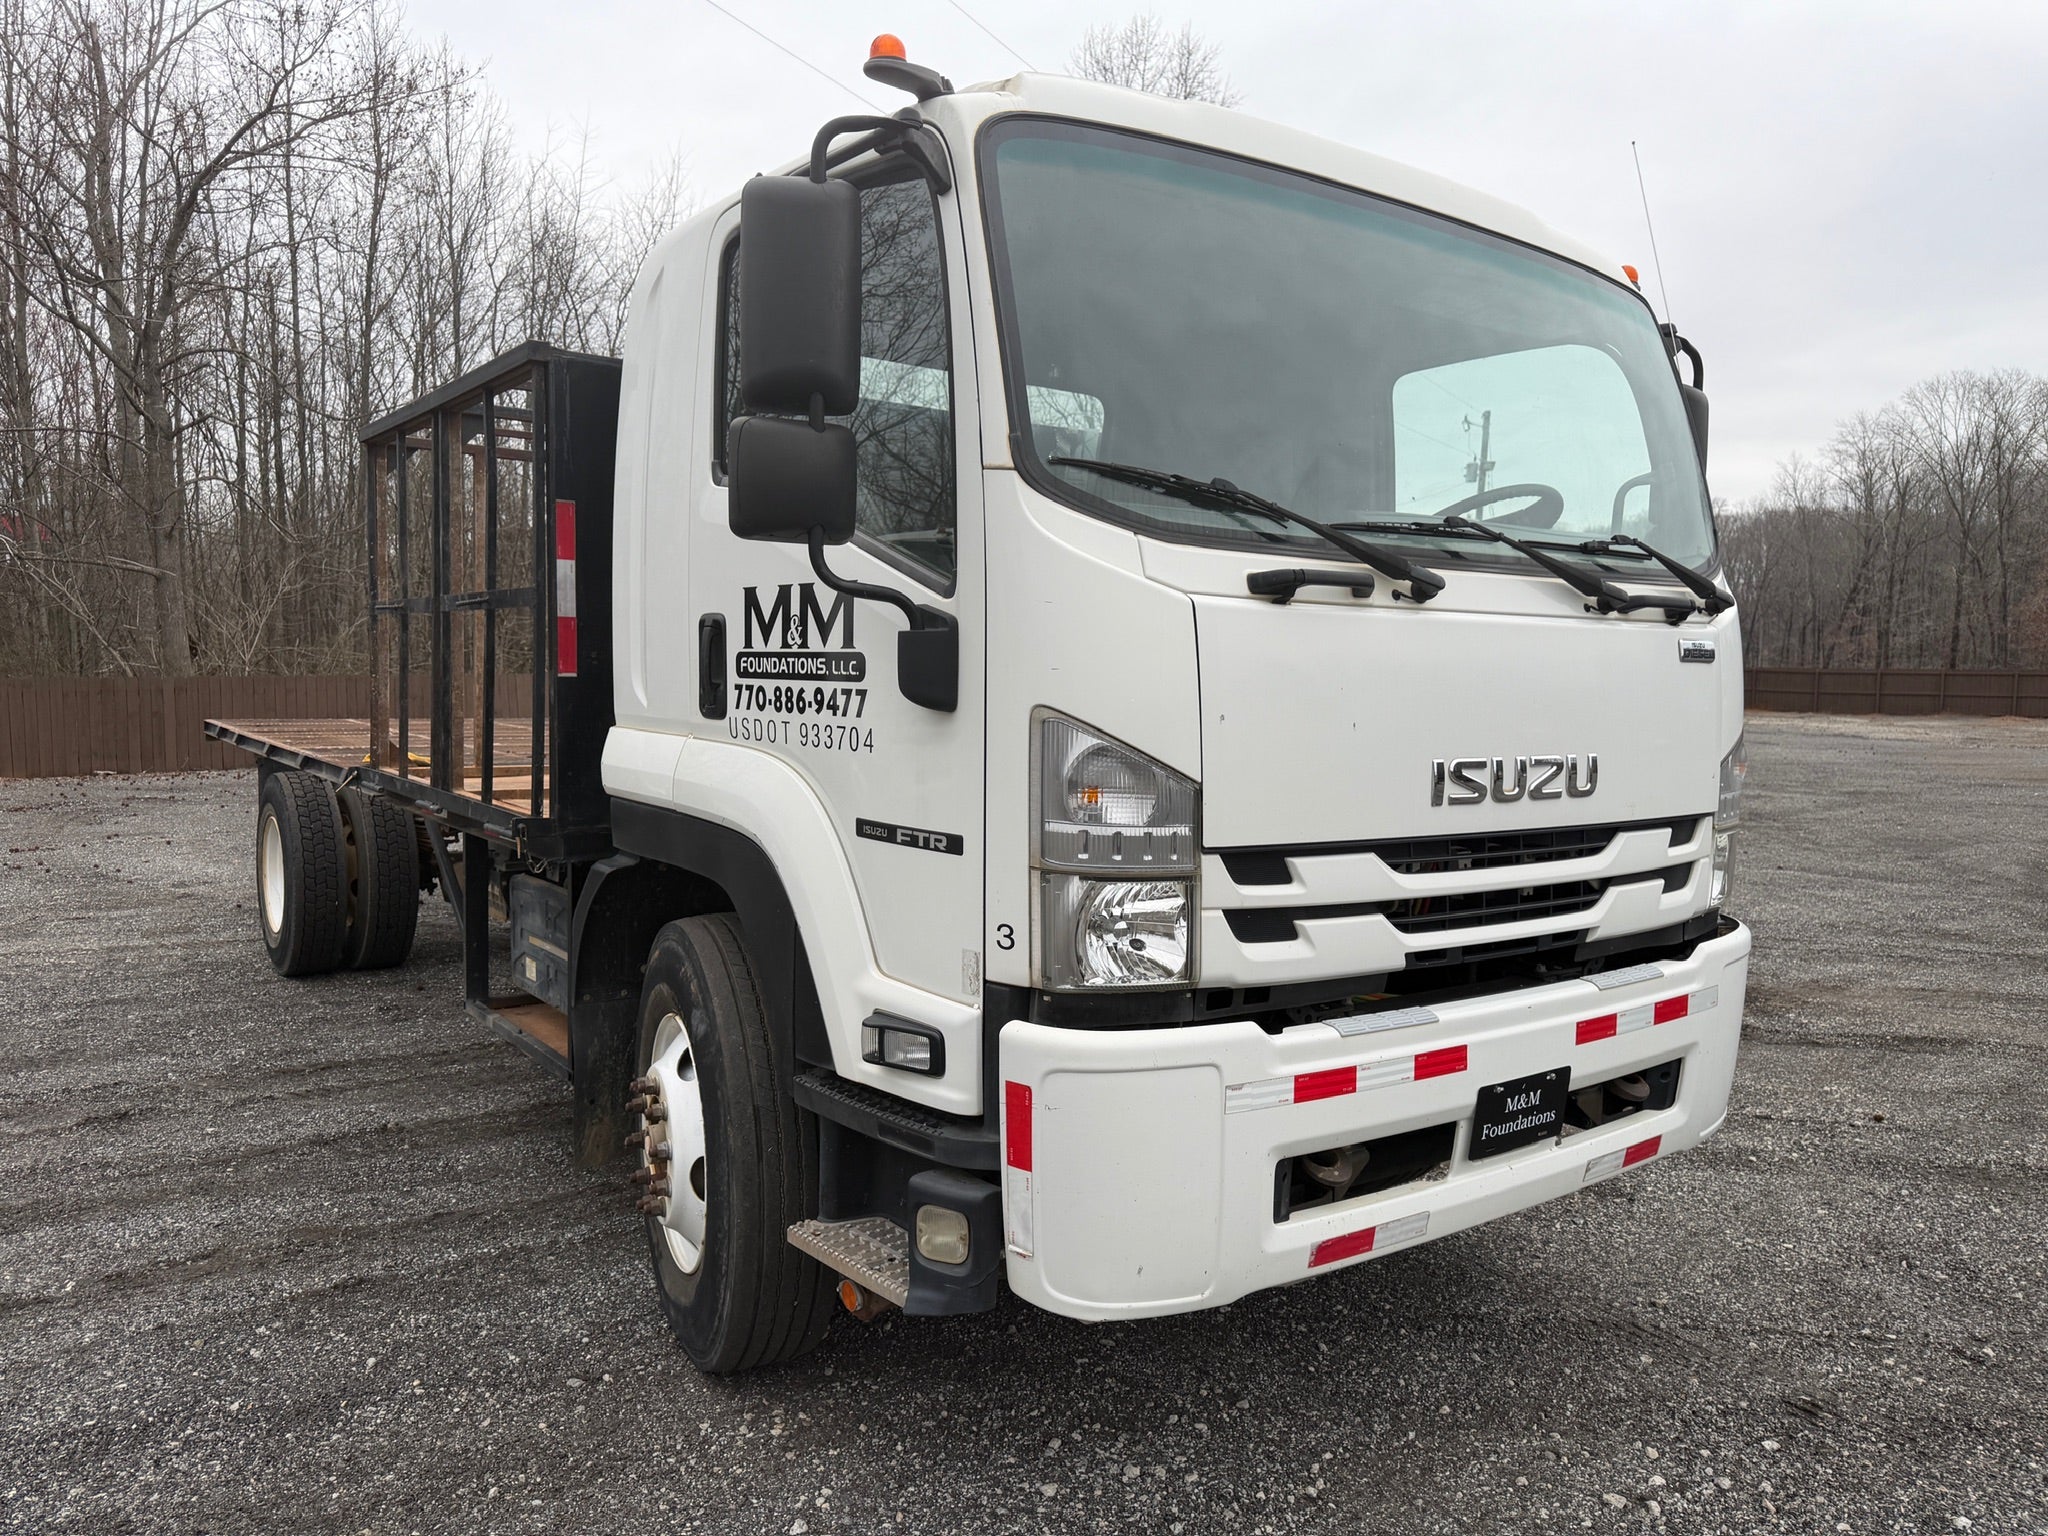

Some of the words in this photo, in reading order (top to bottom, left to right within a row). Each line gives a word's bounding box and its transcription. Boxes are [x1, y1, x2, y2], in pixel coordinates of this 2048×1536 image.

[742, 580, 858, 650] M&M
[740, 657, 829, 676] FOUNDATIONS,
[832, 660, 859, 676] L.L.C.
[729, 716, 790, 745] USDOT
[799, 722, 874, 754] 933704
[1430, 753, 1598, 807] ISUZU
[863, 824, 888, 838] ISUZU
[896, 828, 947, 851] FTR
[996, 923, 1016, 951] 3
[1504, 1089, 1542, 1113] M&M
[1481, 1109, 1556, 1140] Foundations
